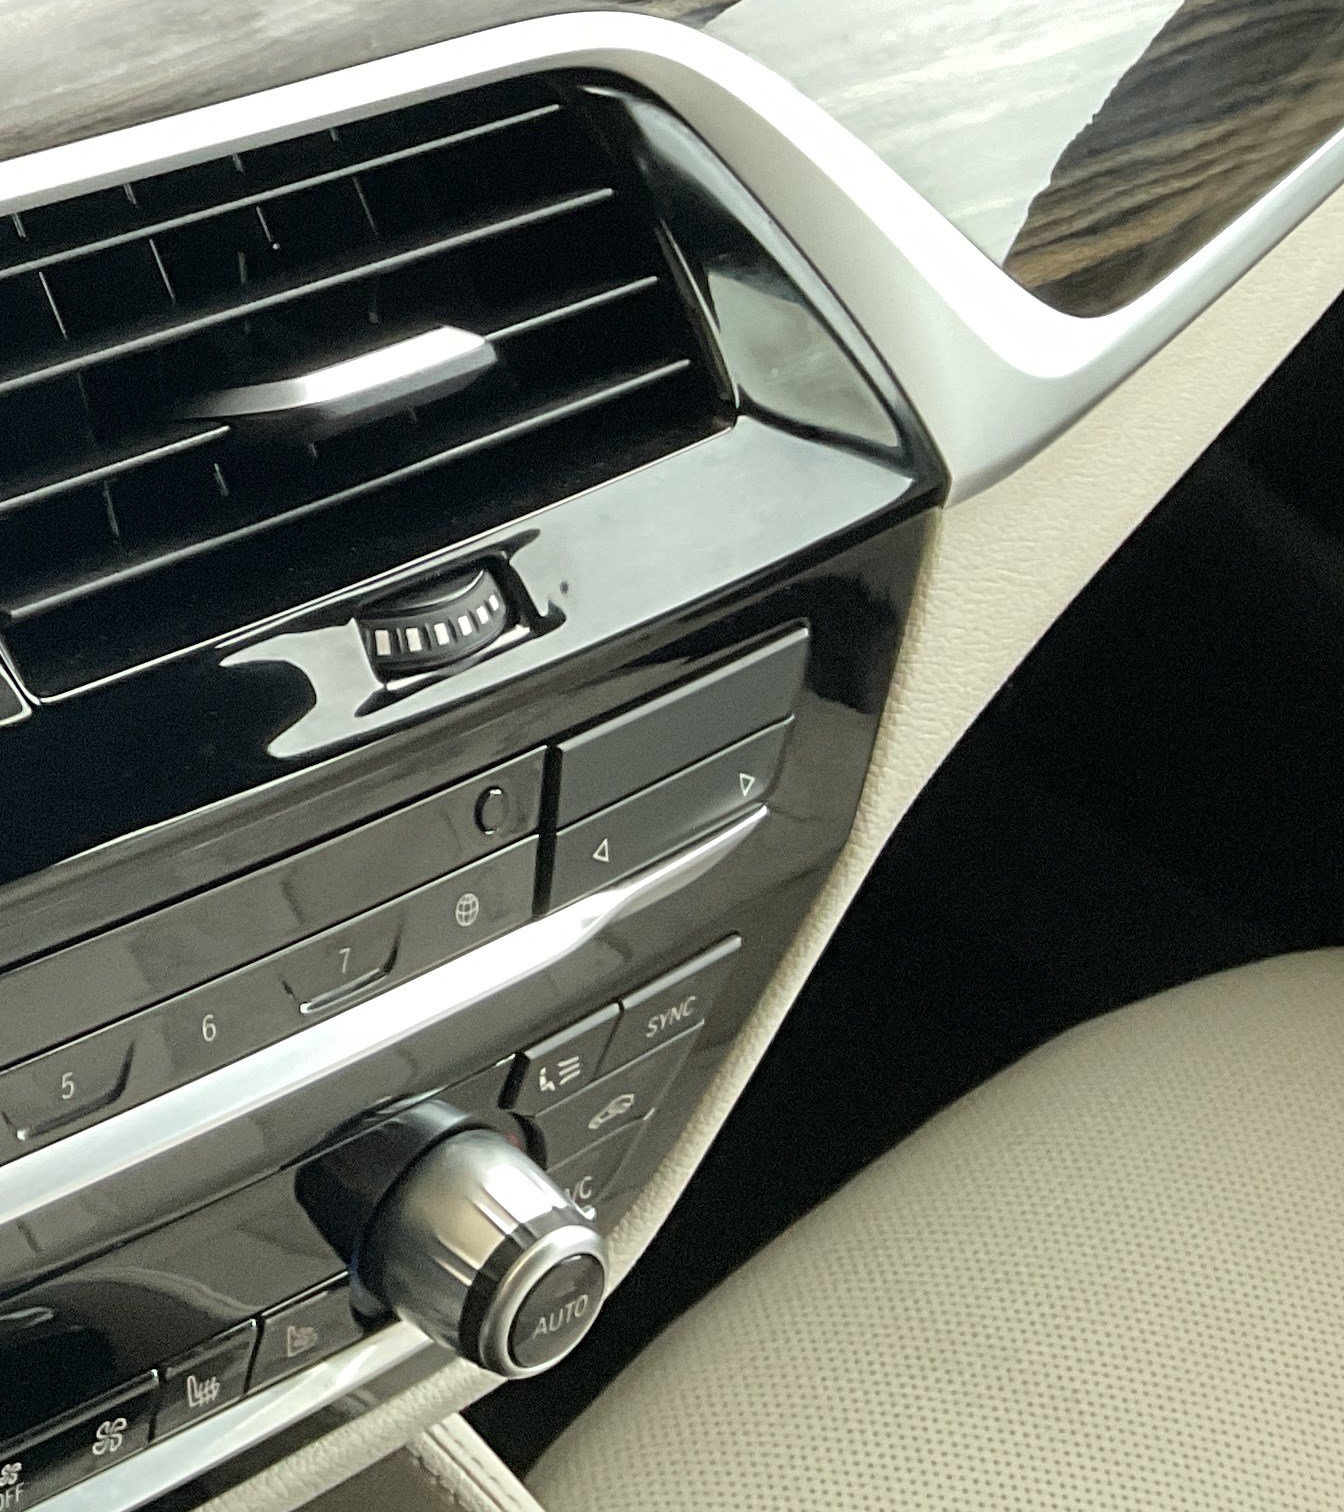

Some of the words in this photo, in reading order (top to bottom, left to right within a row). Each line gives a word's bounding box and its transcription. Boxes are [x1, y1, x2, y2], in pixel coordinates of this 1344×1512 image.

[338, 947, 353, 974] 7
[201, 1013, 217, 1043] 6
[645, 994, 697, 1039] SYNC
[60, 1071, 76, 1100] 5
[531, 1293, 590, 1339] AUTO
